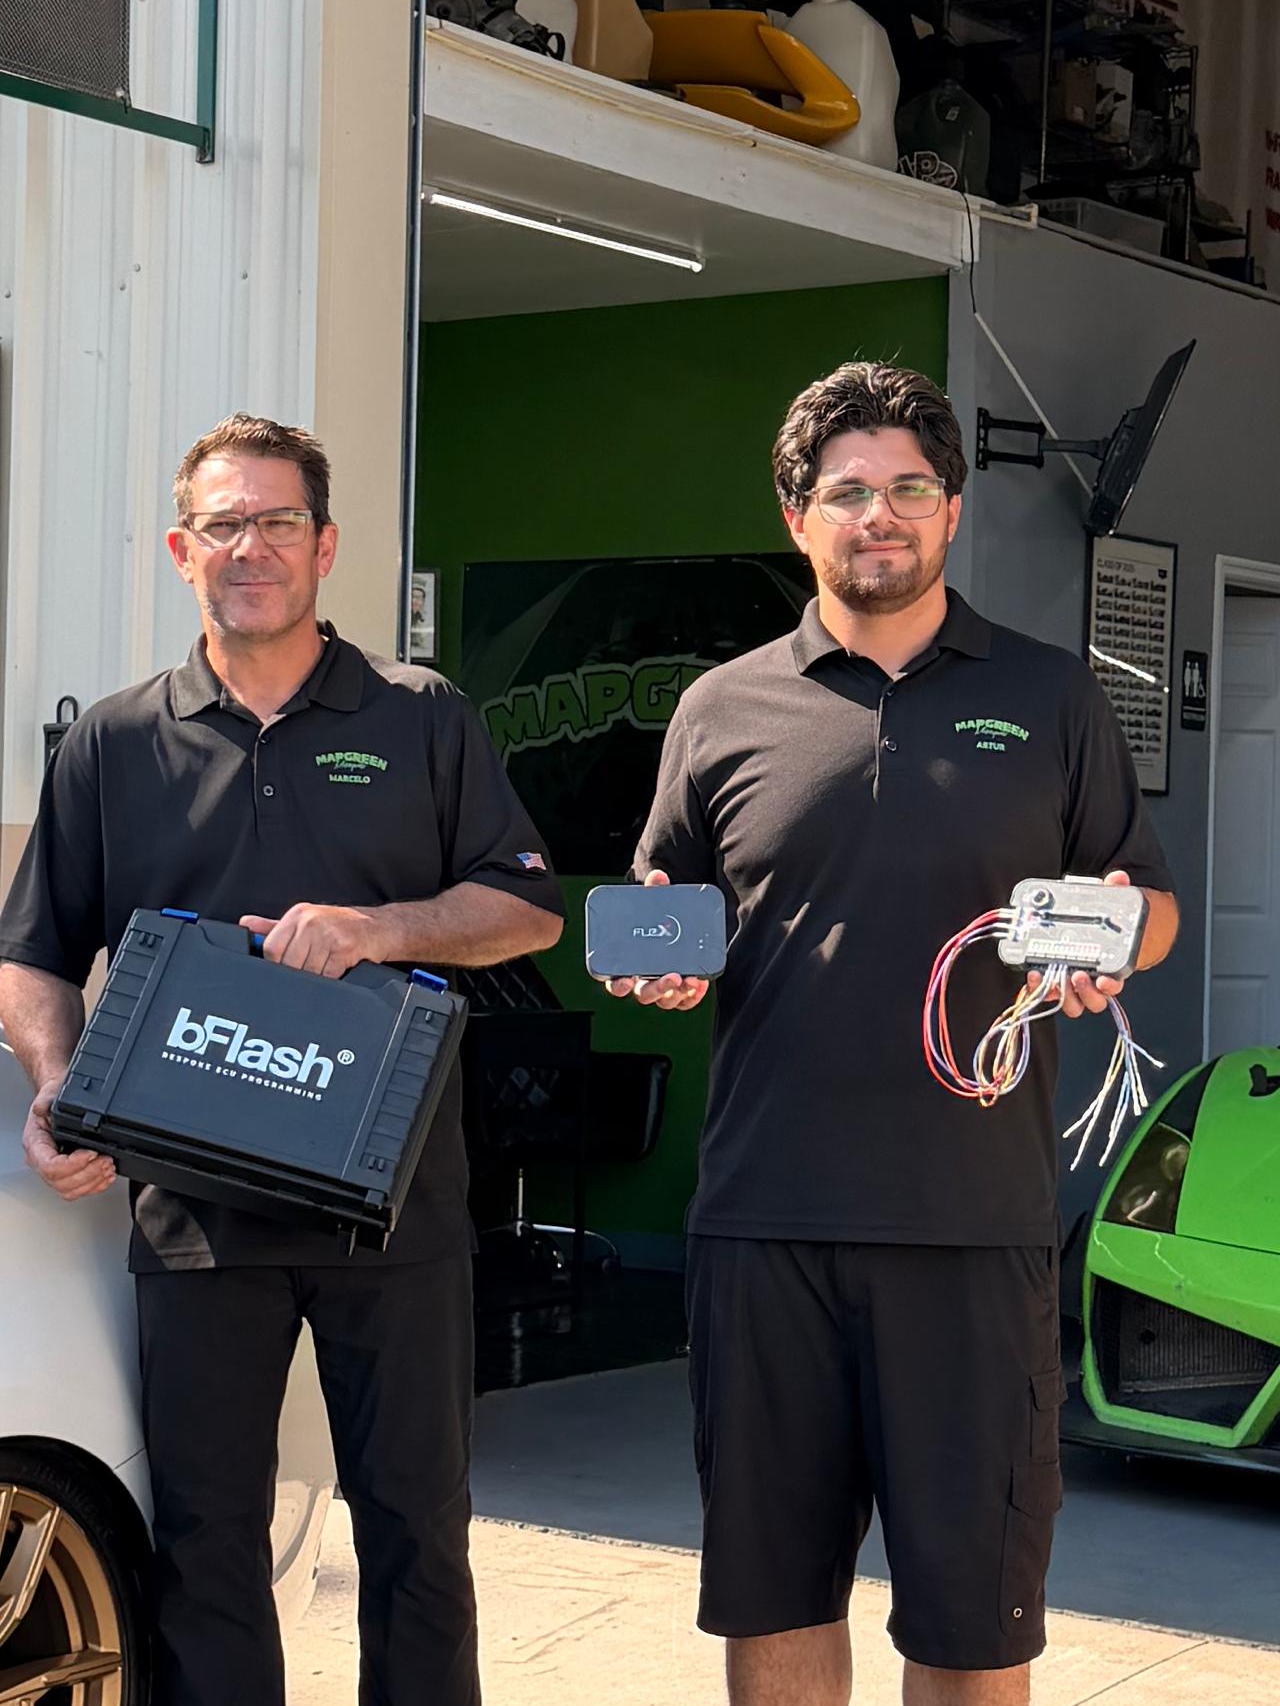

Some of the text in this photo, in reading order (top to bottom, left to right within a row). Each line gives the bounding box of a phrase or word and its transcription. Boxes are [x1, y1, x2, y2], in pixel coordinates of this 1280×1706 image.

[482, 657, 716, 763] MAPG
[955, 719, 1030, 741] MAPGREEN
[315, 752, 388, 771] MAPGREEN
[329, 774, 371, 784] MARCELO
[216, 1066, 237, 1078] ECU
[241, 1073, 323, 1101] PROGRAMMING
